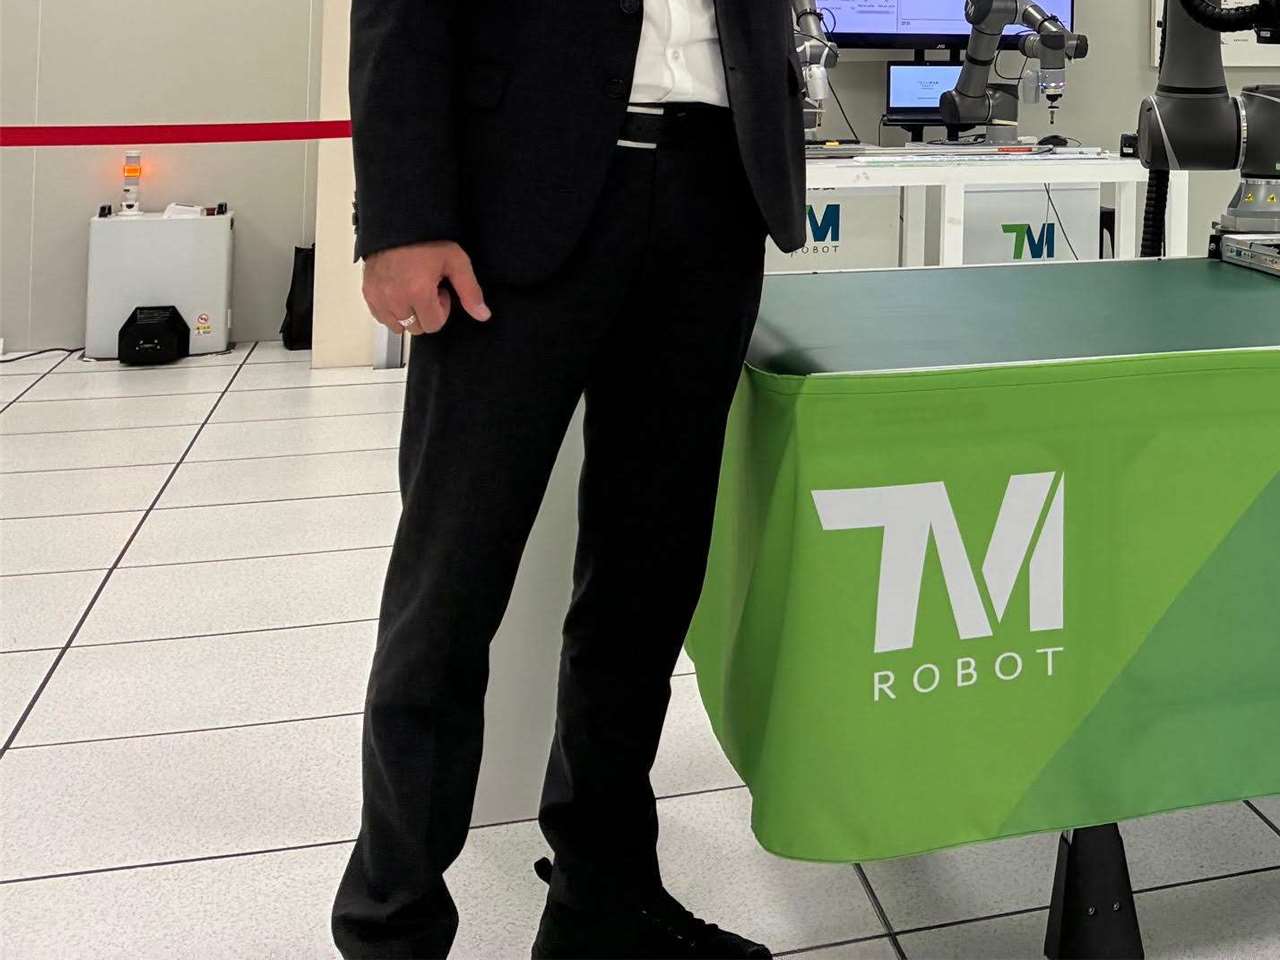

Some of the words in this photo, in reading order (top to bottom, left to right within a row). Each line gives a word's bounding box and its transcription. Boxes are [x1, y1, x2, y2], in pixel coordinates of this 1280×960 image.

[806, 204, 840, 242] M
[1001, 223, 1055, 260] TM
[811, 471, 1064, 654] TM
[873, 646, 1065, 702] ROBOT
